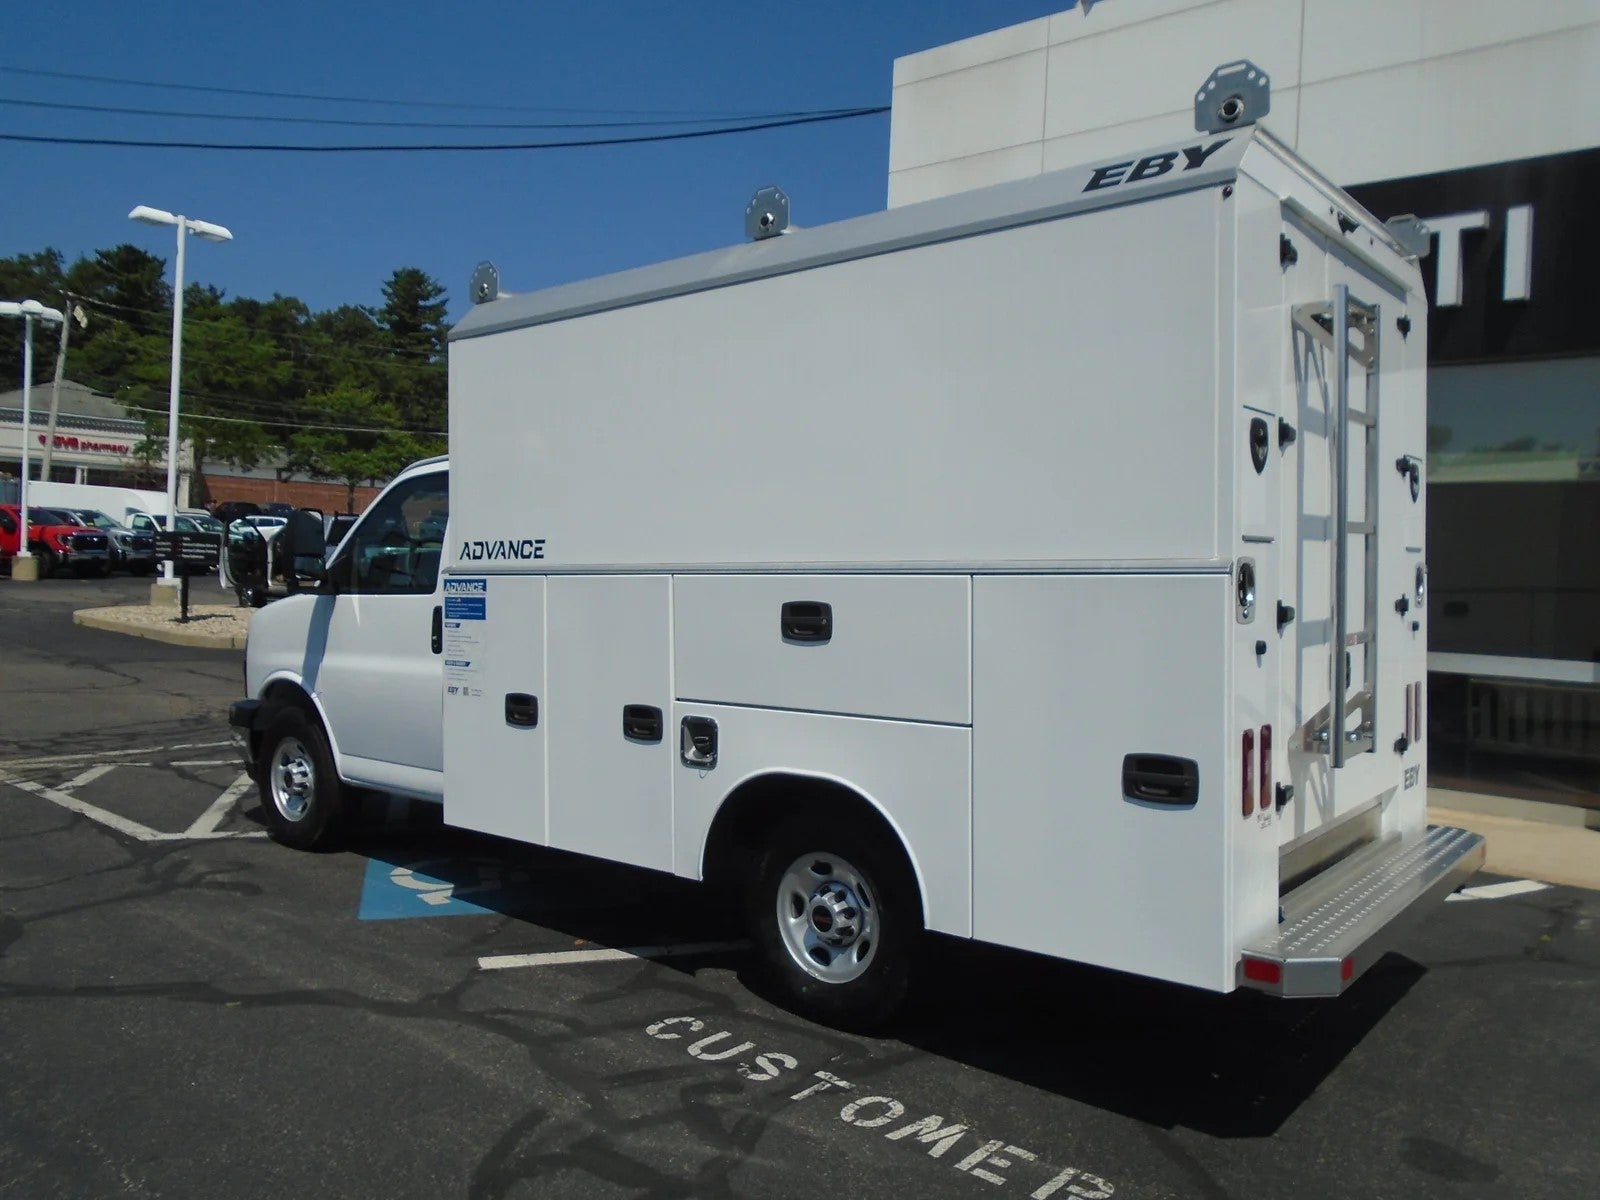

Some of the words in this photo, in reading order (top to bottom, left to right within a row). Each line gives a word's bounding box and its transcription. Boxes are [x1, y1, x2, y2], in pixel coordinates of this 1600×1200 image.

[1082, 137, 1234, 193] EBY
[81, 440, 129, 455] pharmacy
[460, 539, 546, 560] ADVANCE
[445, 582, 484, 592] ADVANCE
[1404, 764, 1420, 790] EBY
[645, 1015, 1116, 1200] CUSTOMER
